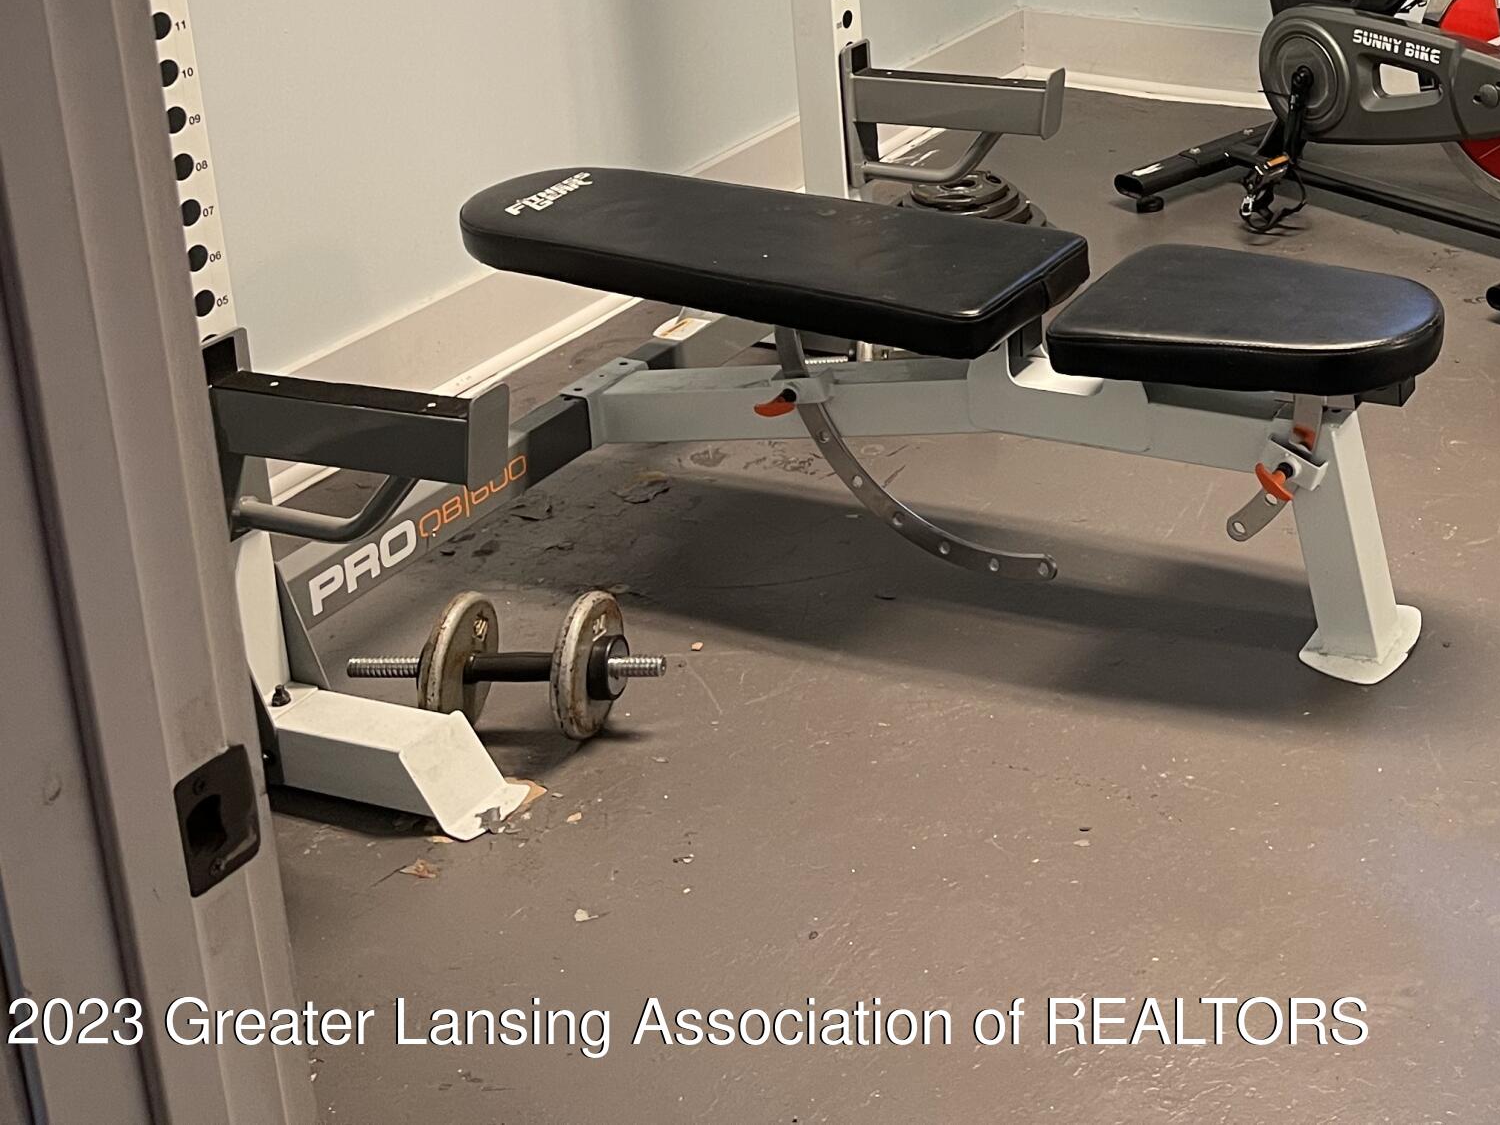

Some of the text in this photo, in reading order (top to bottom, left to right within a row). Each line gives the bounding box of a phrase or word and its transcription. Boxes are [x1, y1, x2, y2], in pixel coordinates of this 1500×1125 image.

[174, 19, 187, 31] 11
[1352, 28, 1441, 65] SUNNY BIKE
[181, 67, 194, 79] 10
[188, 114, 201, 125] 09
[195, 160, 208, 172] 08
[202, 206, 215, 218] 07
[208, 251, 222, 263] 06
[215, 295, 228, 307] 05
[308, 519, 417, 617] PRO
